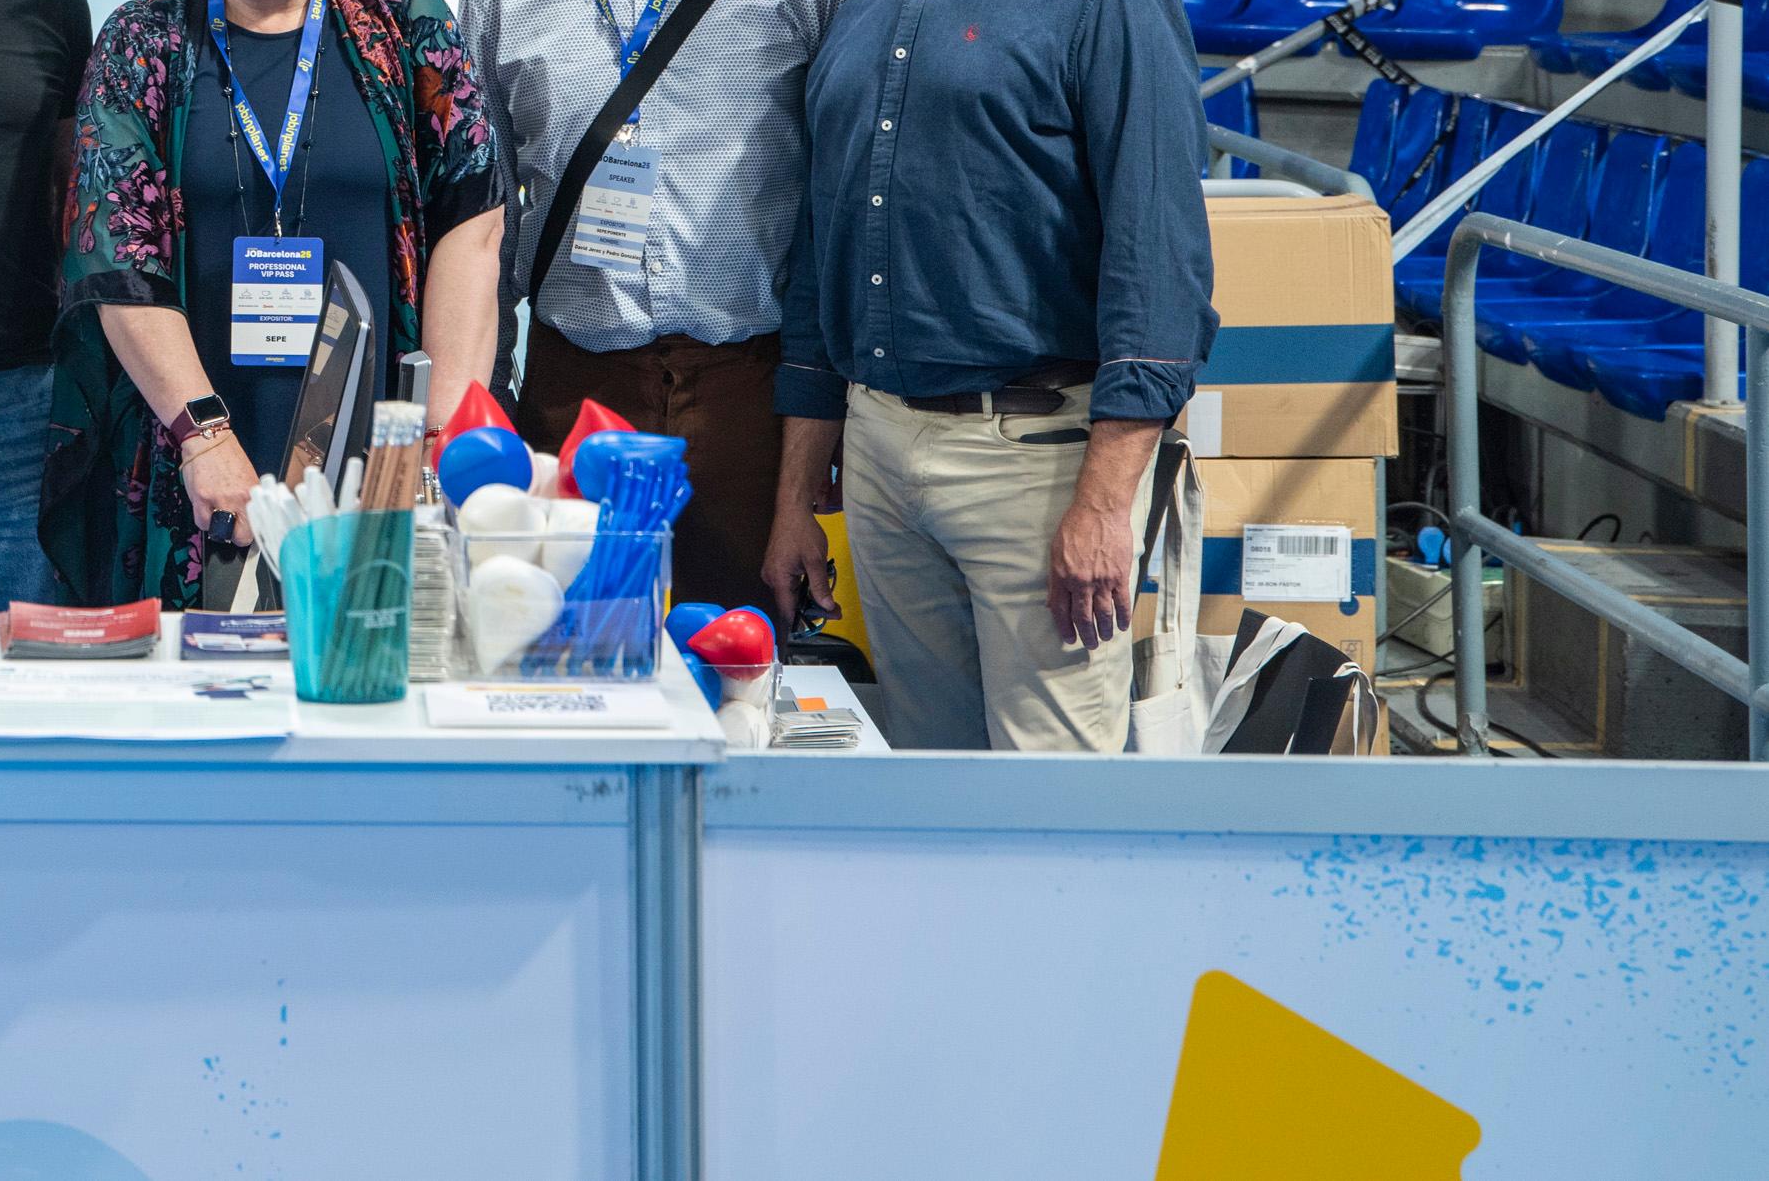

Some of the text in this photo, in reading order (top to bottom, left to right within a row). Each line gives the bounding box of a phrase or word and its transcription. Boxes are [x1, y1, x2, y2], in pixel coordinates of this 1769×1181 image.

[235, 100, 270, 162] jobinplanet
[279, 112, 301, 172] jobinplanet
[609, 173, 636, 184] SPEAKER
[244, 249, 312, 259] JOBarcelona25
[249, 263, 307, 271] PROFESSIONAL
[261, 270, 295, 278] VIP PASS
[265, 335, 287, 343] SEPE
